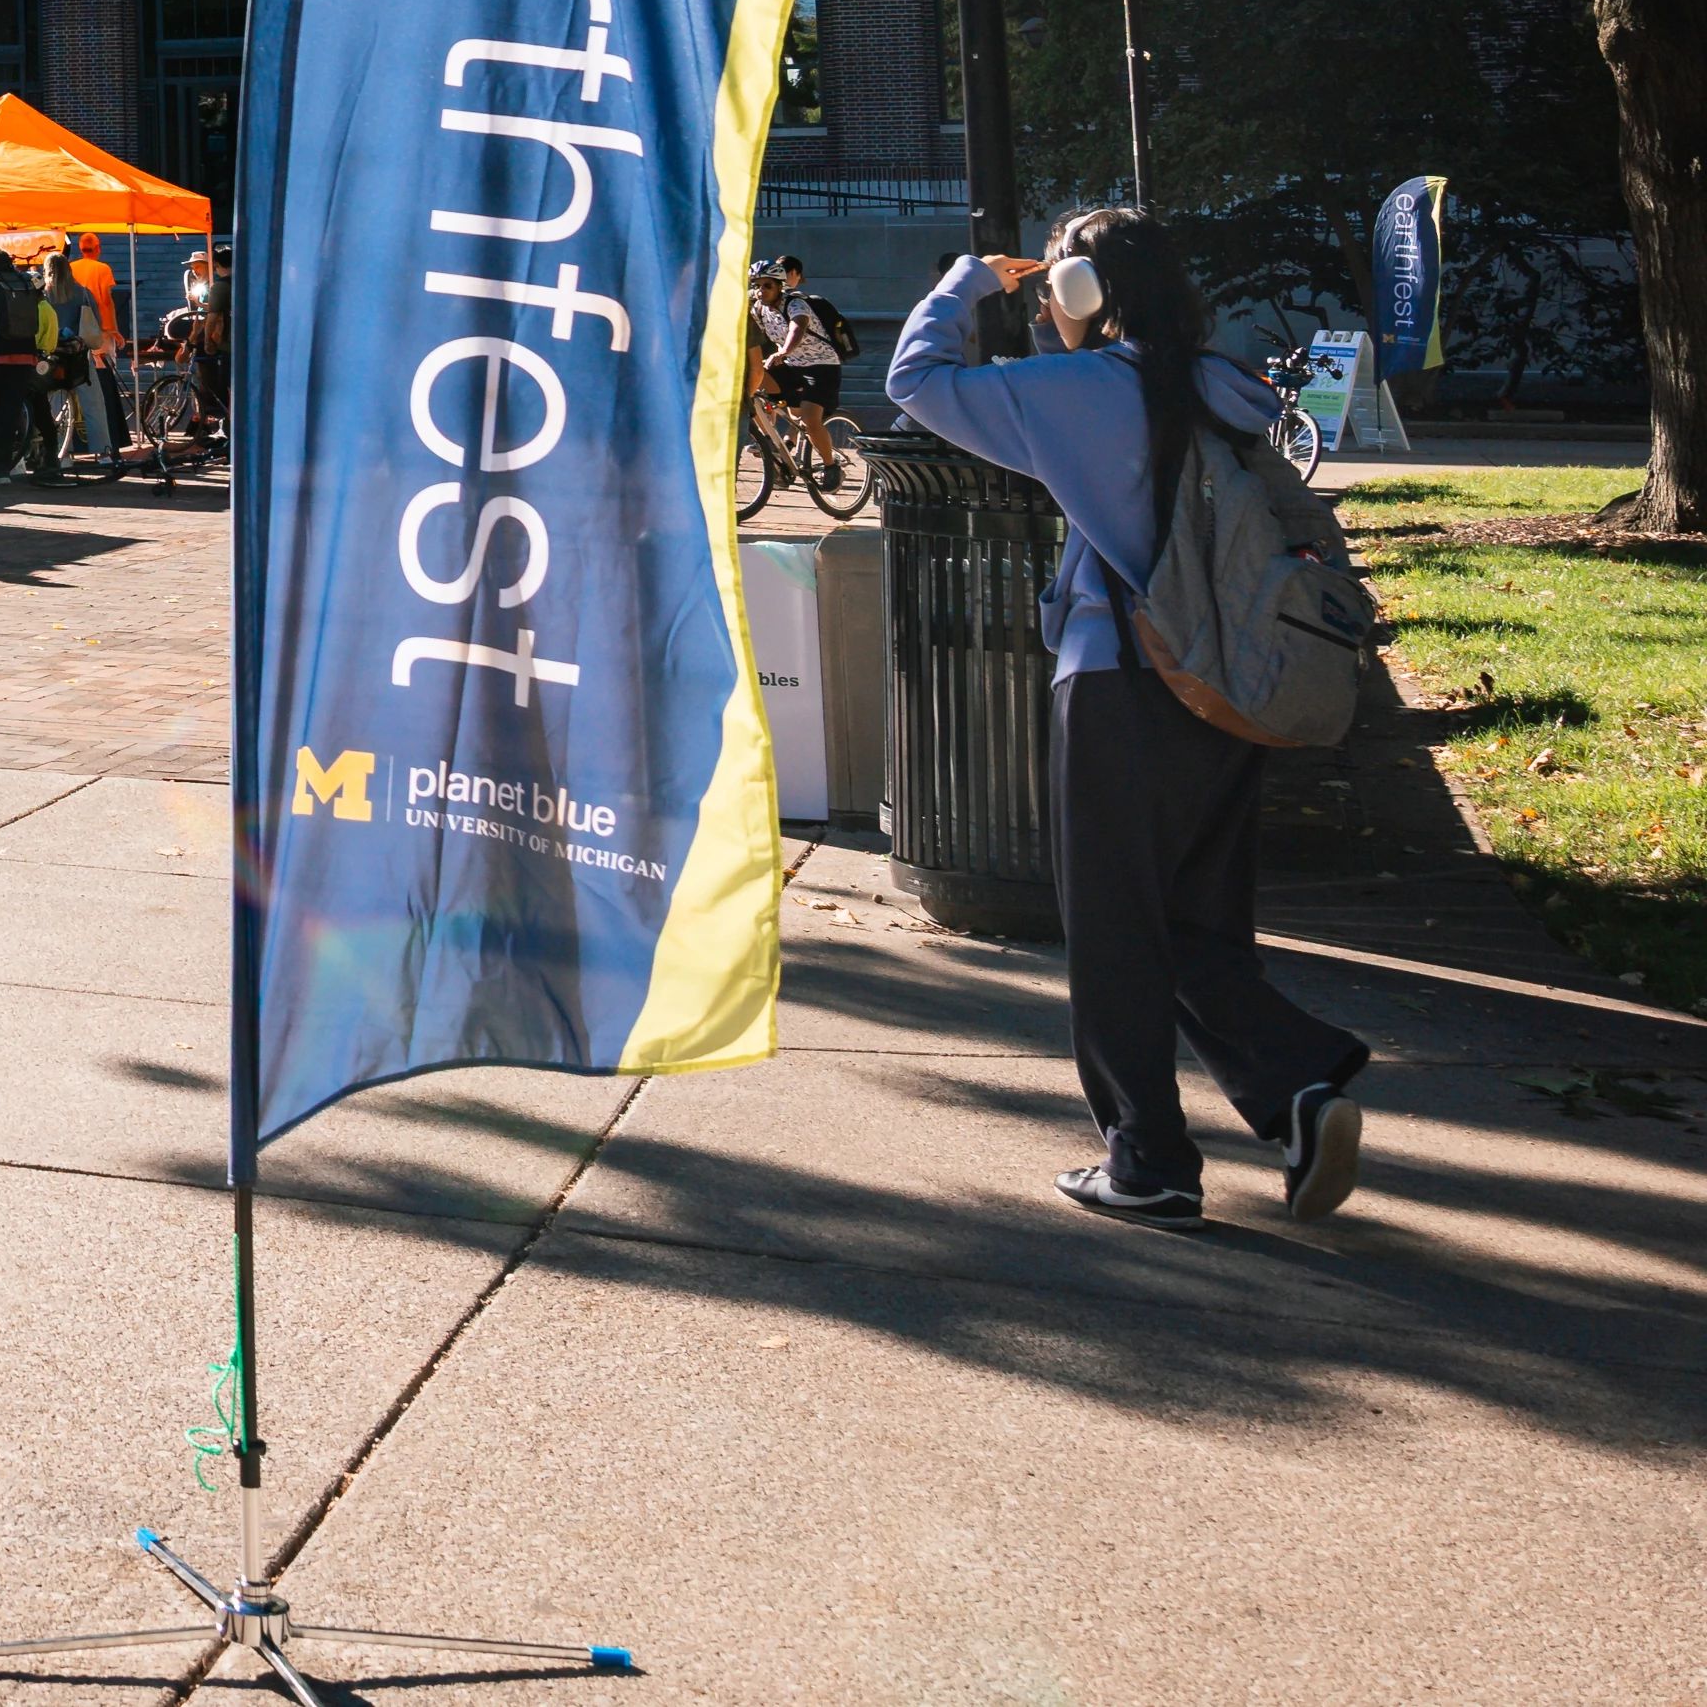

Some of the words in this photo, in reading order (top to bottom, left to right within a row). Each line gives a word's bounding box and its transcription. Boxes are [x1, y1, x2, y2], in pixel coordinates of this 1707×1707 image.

[1393, 193, 1418, 328] earthfest
[291, 745, 375, 822] M
[407, 759, 525, 817] planet
[532, 782, 616, 837] blue
[405, 807, 526, 846] UNIVERSITY
[529, 835, 551, 854] OF
[554, 841, 667, 882] MICHIGAN
